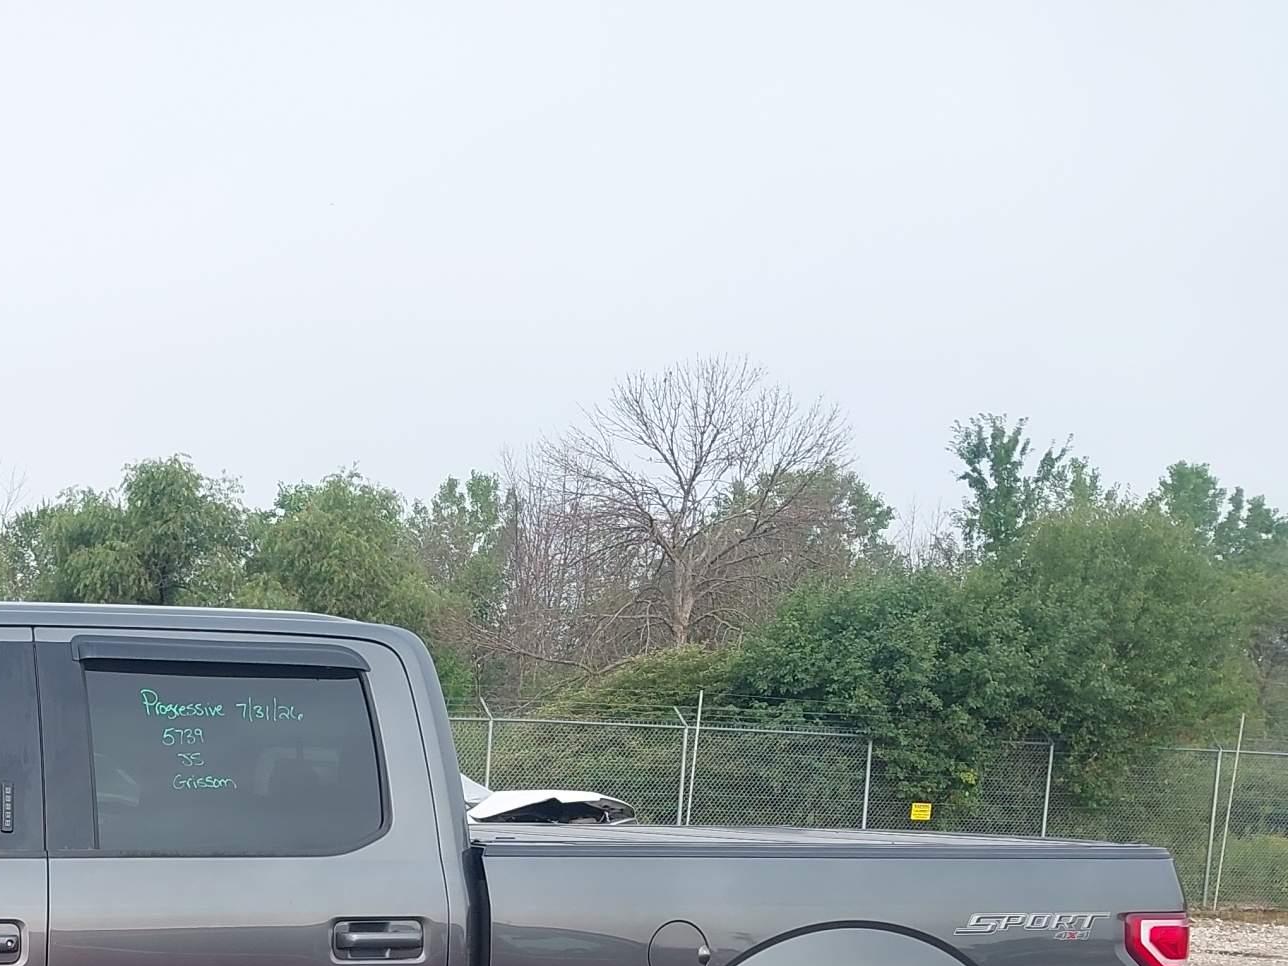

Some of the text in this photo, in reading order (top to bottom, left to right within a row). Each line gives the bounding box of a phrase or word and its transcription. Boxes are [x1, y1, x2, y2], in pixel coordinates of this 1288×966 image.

[140, 689, 225, 719] Progressive
[162, 728, 204, 746] 5739
[172, 774, 237, 790] Grissom
[953, 912, 1111, 936] SPORT
